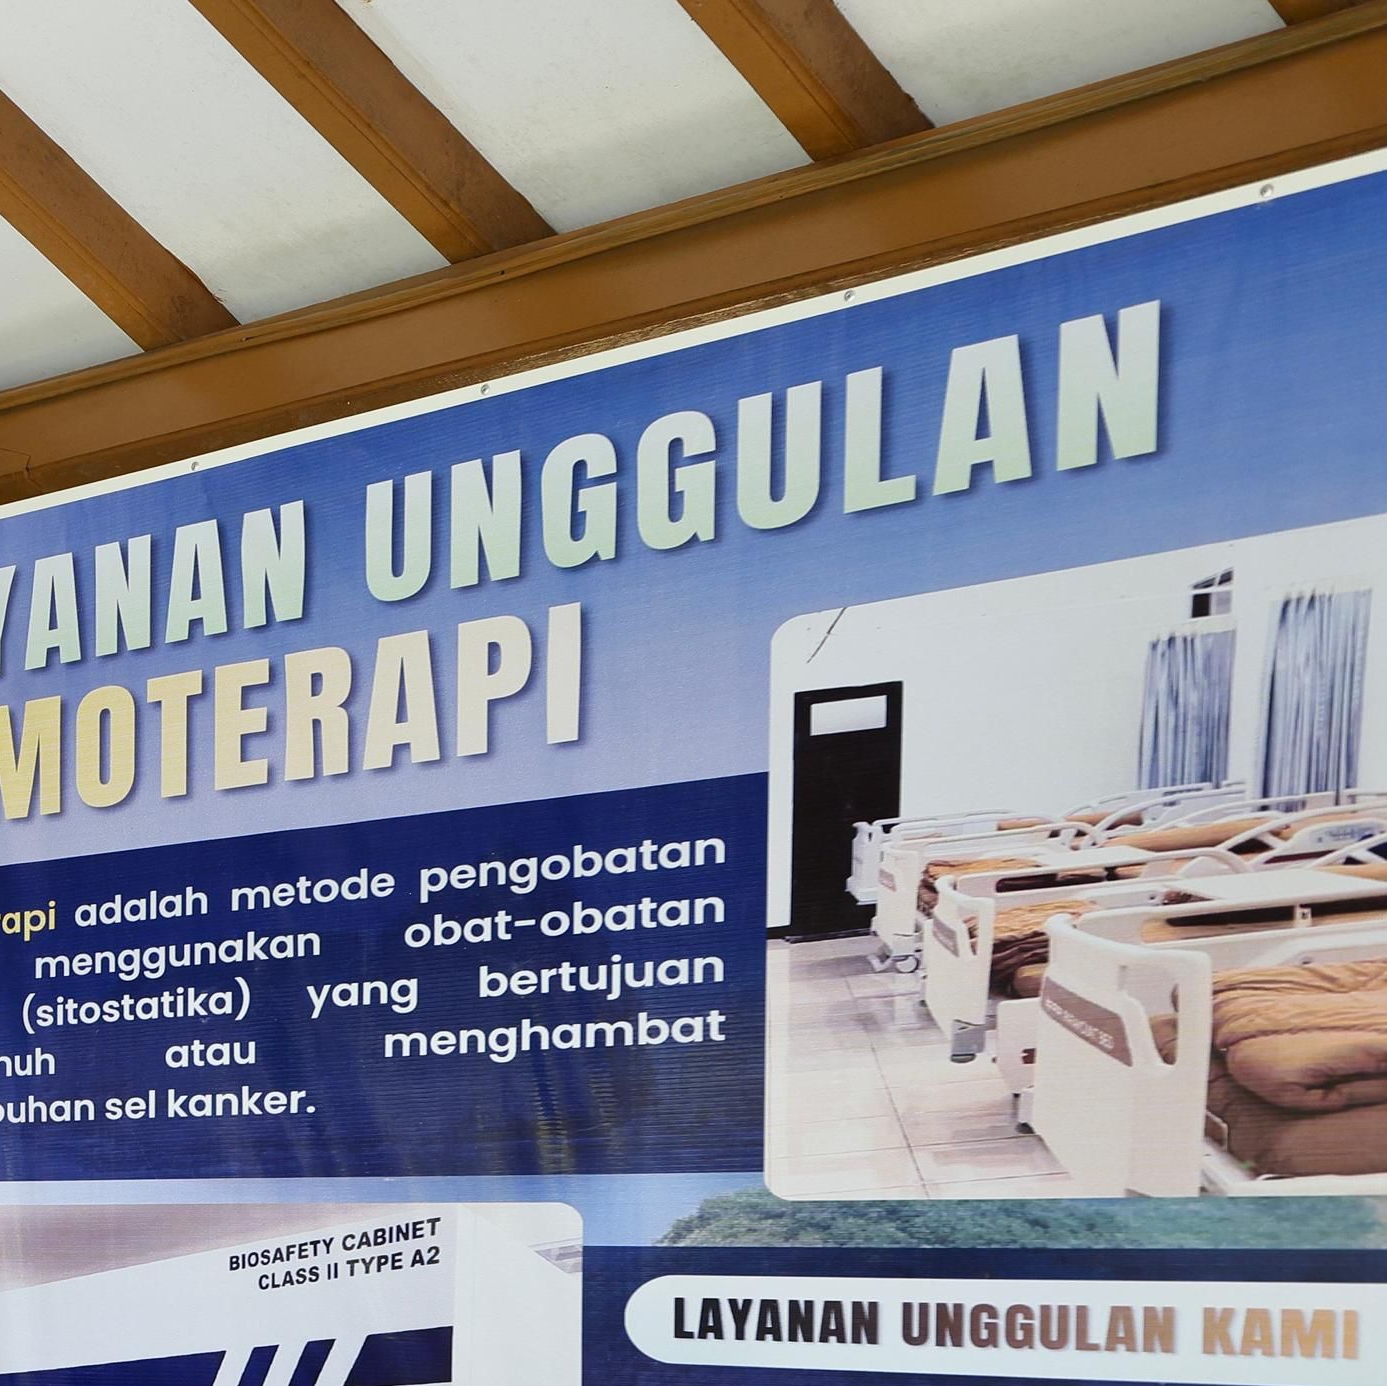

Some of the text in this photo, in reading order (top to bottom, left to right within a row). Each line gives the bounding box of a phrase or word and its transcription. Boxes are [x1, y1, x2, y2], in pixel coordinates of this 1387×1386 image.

[365, 300, 1160, 603] UNGGULAN
[75, 887, 207, 926] adalah
[232, 868, 394, 911] metode
[421, 838, 725, 903] pengobatan
[36, 932, 320, 981] menggunakan
[405, 897, 724, 947] obat-obatan
[23, 977, 250, 1034] (sitostatika)
[307, 979, 417, 1018] yang
[480, 955, 723, 1000] bertujuan
[166, 1040, 255, 1068] atau
[385, 1010, 726, 1062] menghambat
[106, 1090, 155, 1120] sel
[168, 1086, 315, 1117] kanker.
[230, 1217, 440, 1270] BIOSAFETY CABINET
[259, 1246, 439, 1290] CLASS II TYPE A2
[674, 1298, 1359, 1359] LAYANAN UNGGULAN KAMI
